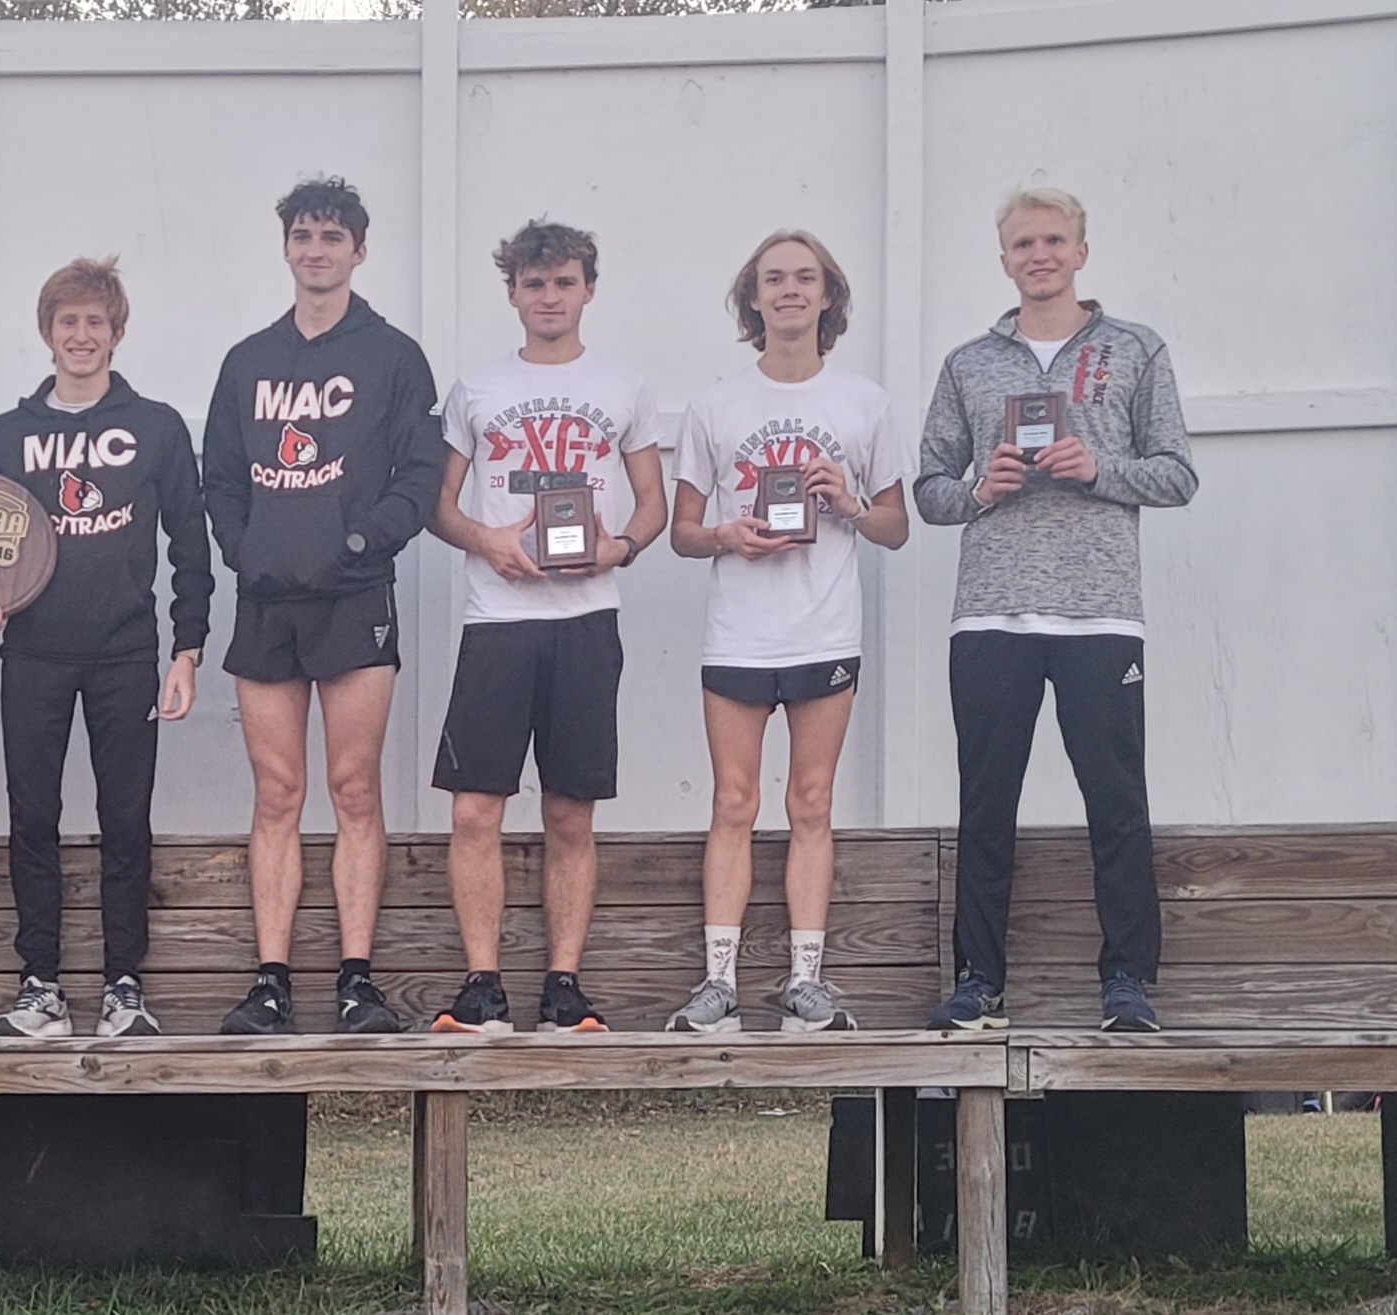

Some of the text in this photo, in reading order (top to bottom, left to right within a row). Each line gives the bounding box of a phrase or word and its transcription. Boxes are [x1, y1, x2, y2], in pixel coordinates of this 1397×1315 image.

[254, 375, 354, 420] MAC
[483, 397, 618, 440] MINERAL AREA
[23, 428, 137, 473] MAC
[807, 426, 847, 464] AREA
[250, 454, 346, 489] CC/TRACK
[489, 475, 606, 491] 20 22
